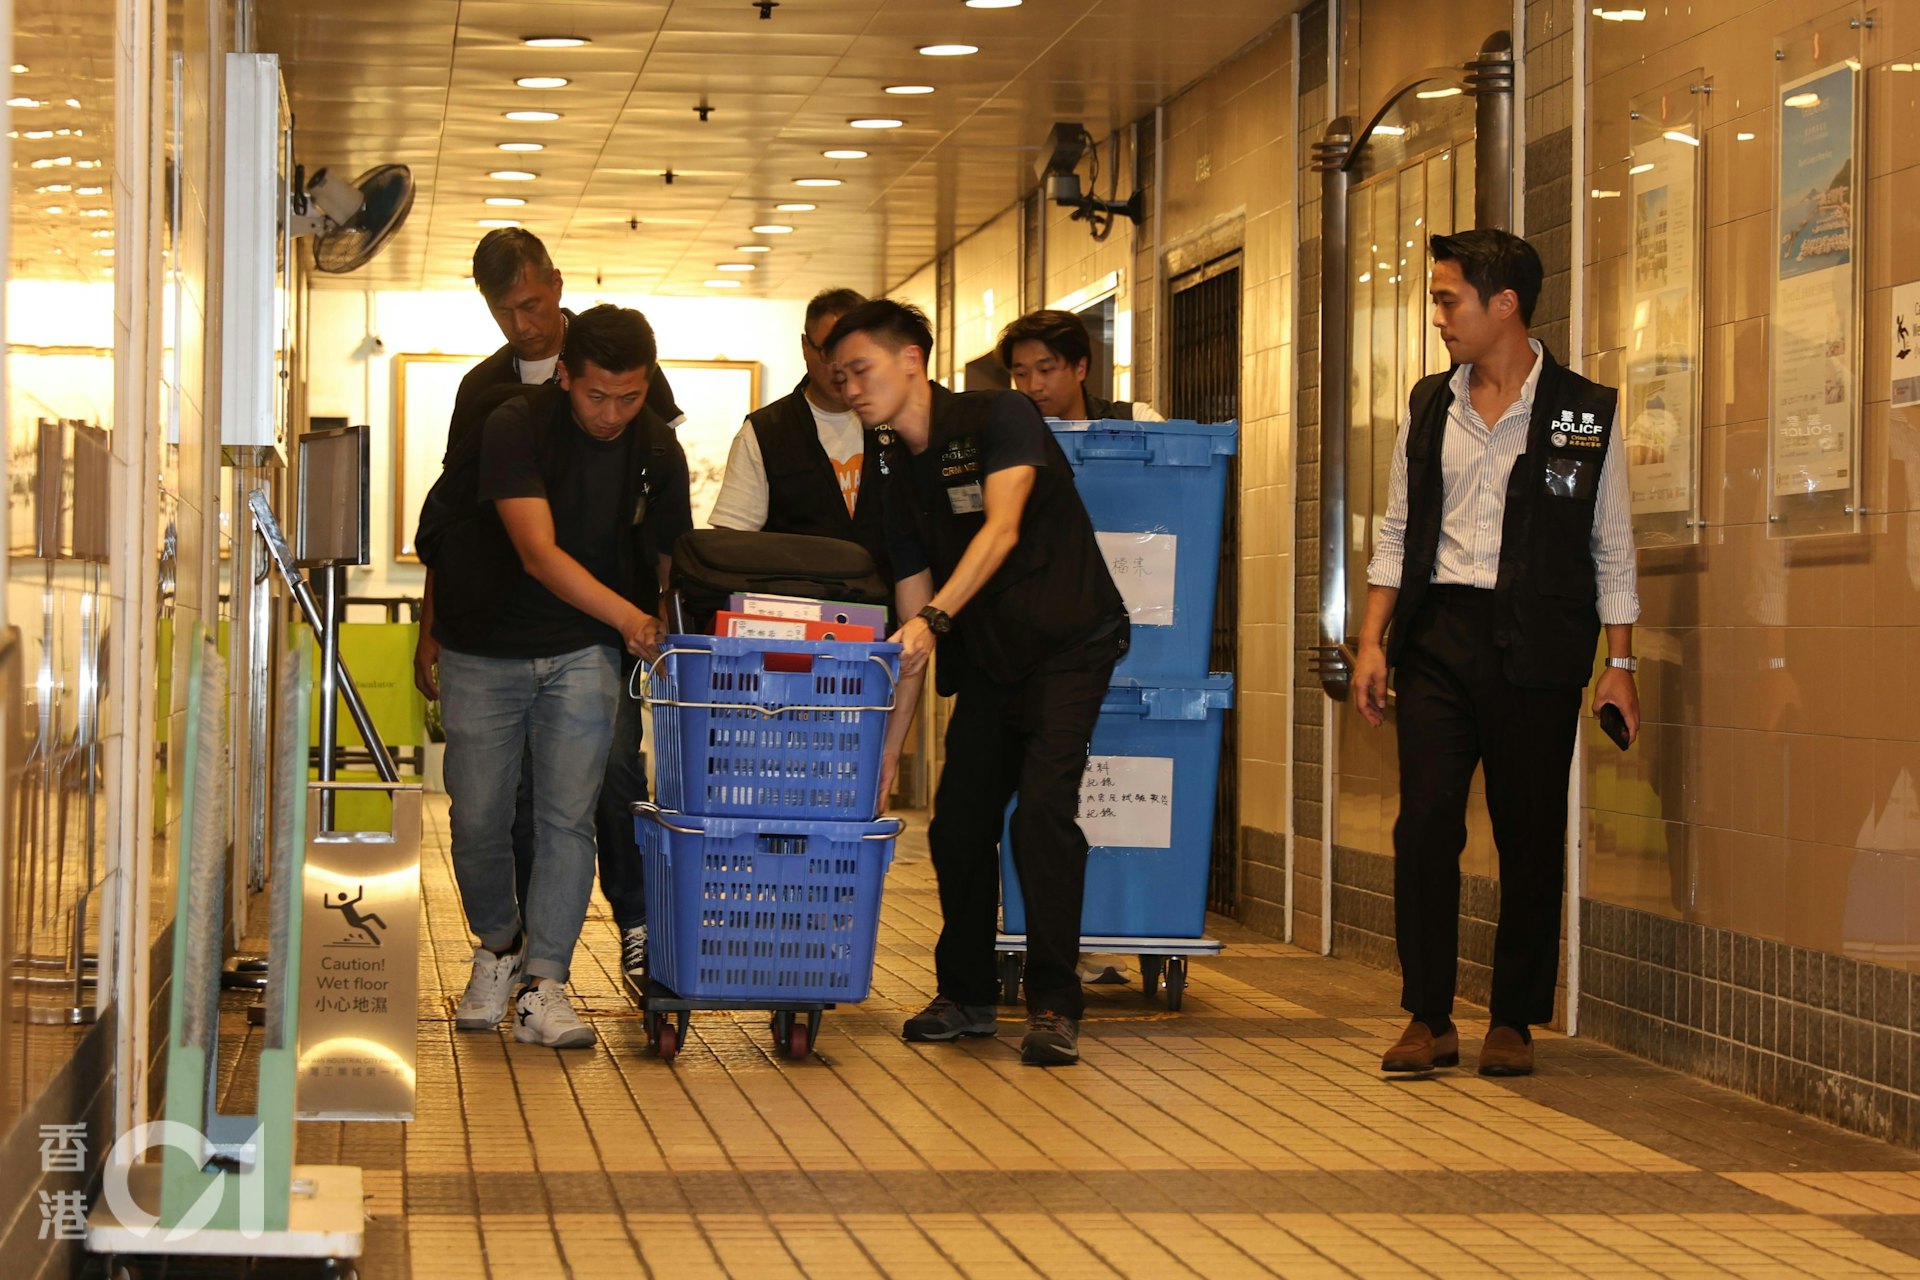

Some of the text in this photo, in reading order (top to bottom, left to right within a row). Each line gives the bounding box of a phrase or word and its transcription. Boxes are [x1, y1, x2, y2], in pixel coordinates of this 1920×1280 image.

[1561, 409, 1595, 425] 警察
[321, 956, 385, 971] Caution!
[316, 976, 389, 991] Wet floor
[315, 995, 388, 1013] 小心地濕
